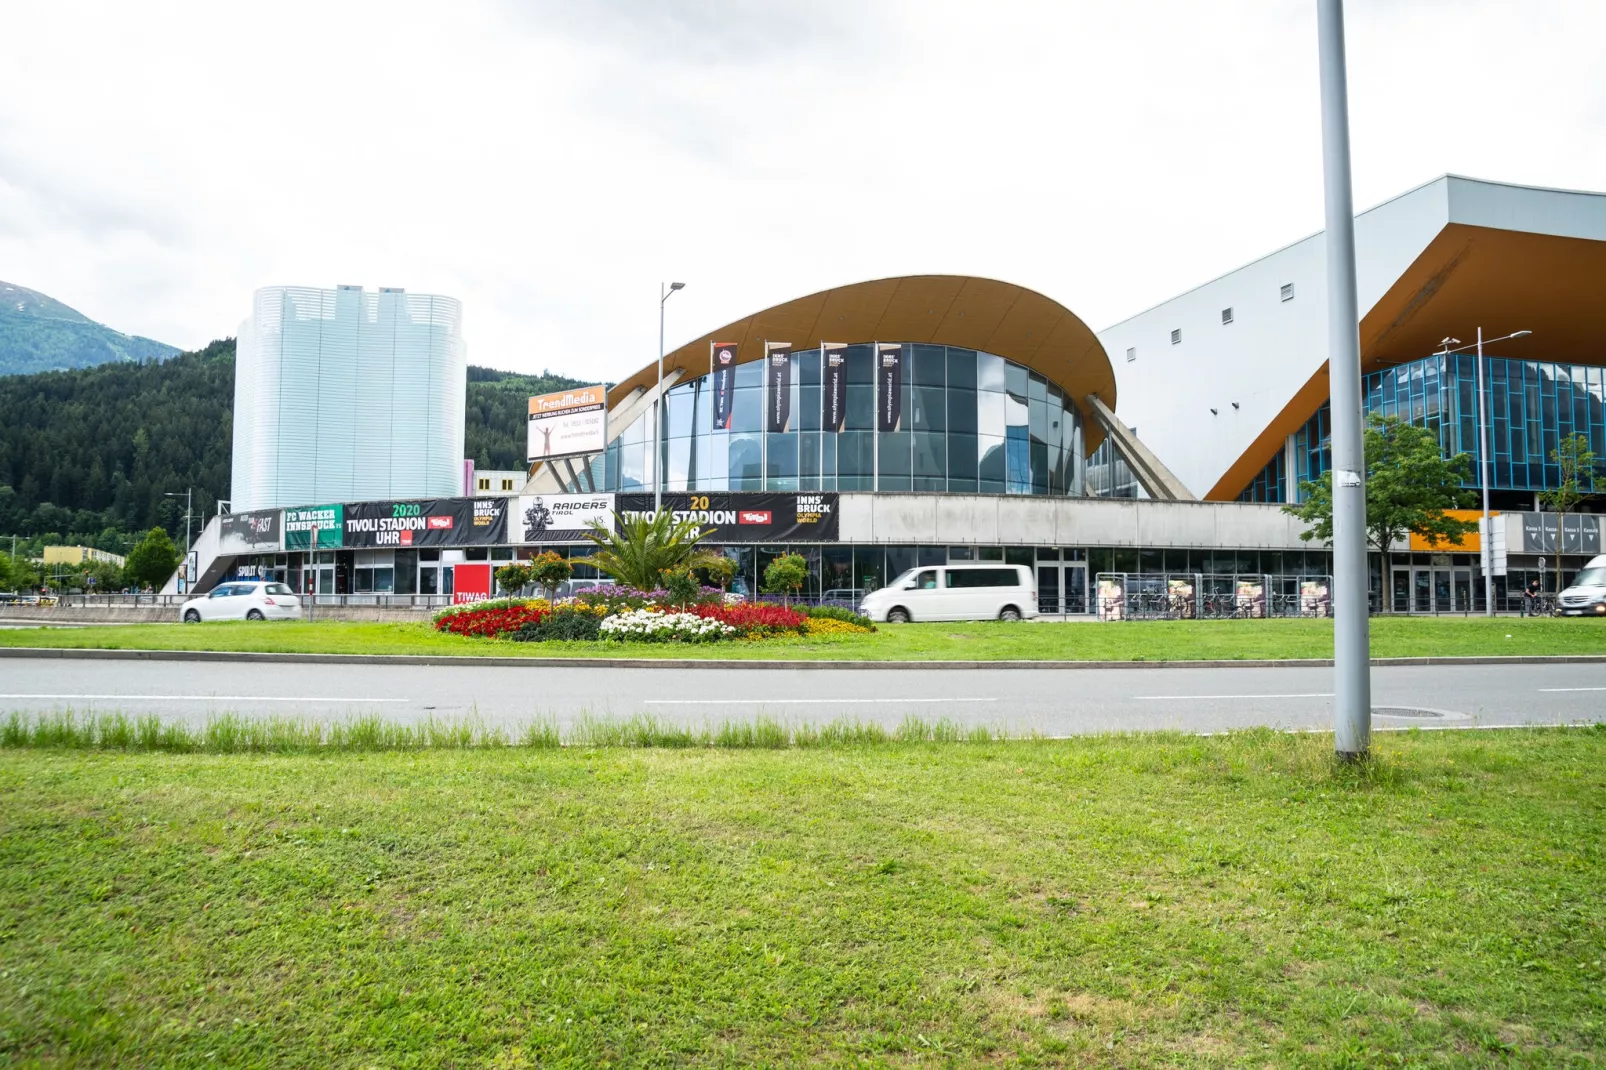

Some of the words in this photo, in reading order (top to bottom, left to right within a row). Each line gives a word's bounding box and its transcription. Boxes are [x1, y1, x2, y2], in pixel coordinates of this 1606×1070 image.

[537, 391, 596, 411] TrendMedia
[552, 501, 608, 510] RAIDERS
[689, 496, 710, 510] 20
[797, 504, 830, 513] BRUCK
[286, 511, 297, 521] FC
[298, 509, 335, 520] WACKER
[392, 504, 420, 517] 2020
[474, 508, 500, 517] BRUCK
[672, 510, 736, 525] STADION
[347, 518, 378, 532] TIVOLI
[379, 517, 426, 531] STADION
[376, 531, 400, 545] UHR
[456, 591, 488, 602] TIWAG
